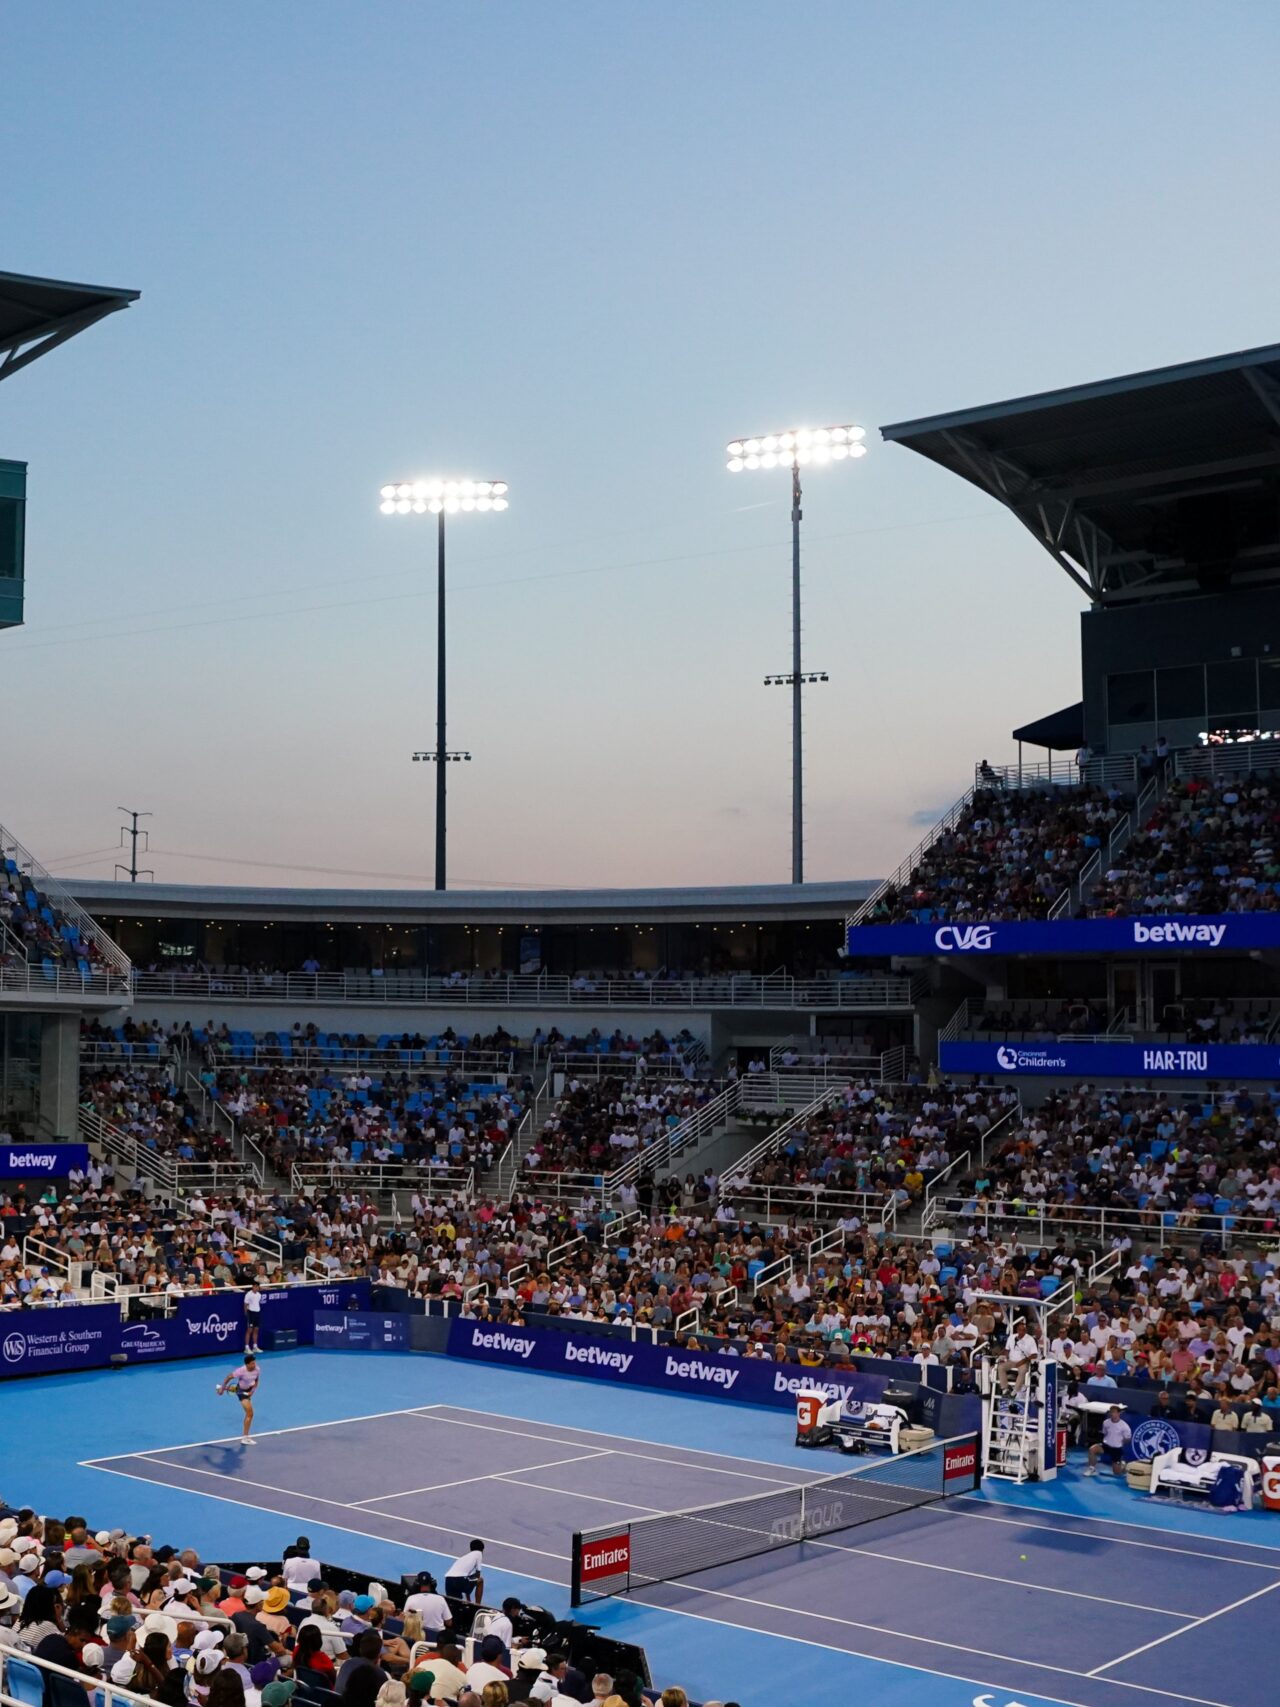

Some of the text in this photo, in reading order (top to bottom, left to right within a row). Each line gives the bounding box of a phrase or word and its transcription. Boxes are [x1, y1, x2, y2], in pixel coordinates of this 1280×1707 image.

[935, 925, 997, 950] CVG
[1134, 922, 1226, 946] betway
[1018, 1057, 1066, 1067] Children's
[1144, 1051, 1207, 1070] HAR-TRU
[9, 1153, 57, 1169] betway
[323, 1294, 335, 1304] 101
[27, 1330, 102, 1344] Western & Southern
[202, 1313, 238, 1341] Kroger
[315, 1324, 343, 1333] betway
[28, 1342, 90, 1357] Financial Group
[472, 1328, 536, 1358] betway
[565, 1342, 633, 1373] betway
[665, 1356, 740, 1389] betway
[797, 1402, 811, 1425] G
[946, 1455, 974, 1470] Emirates
[584, 1548, 628, 1570] Emirates
